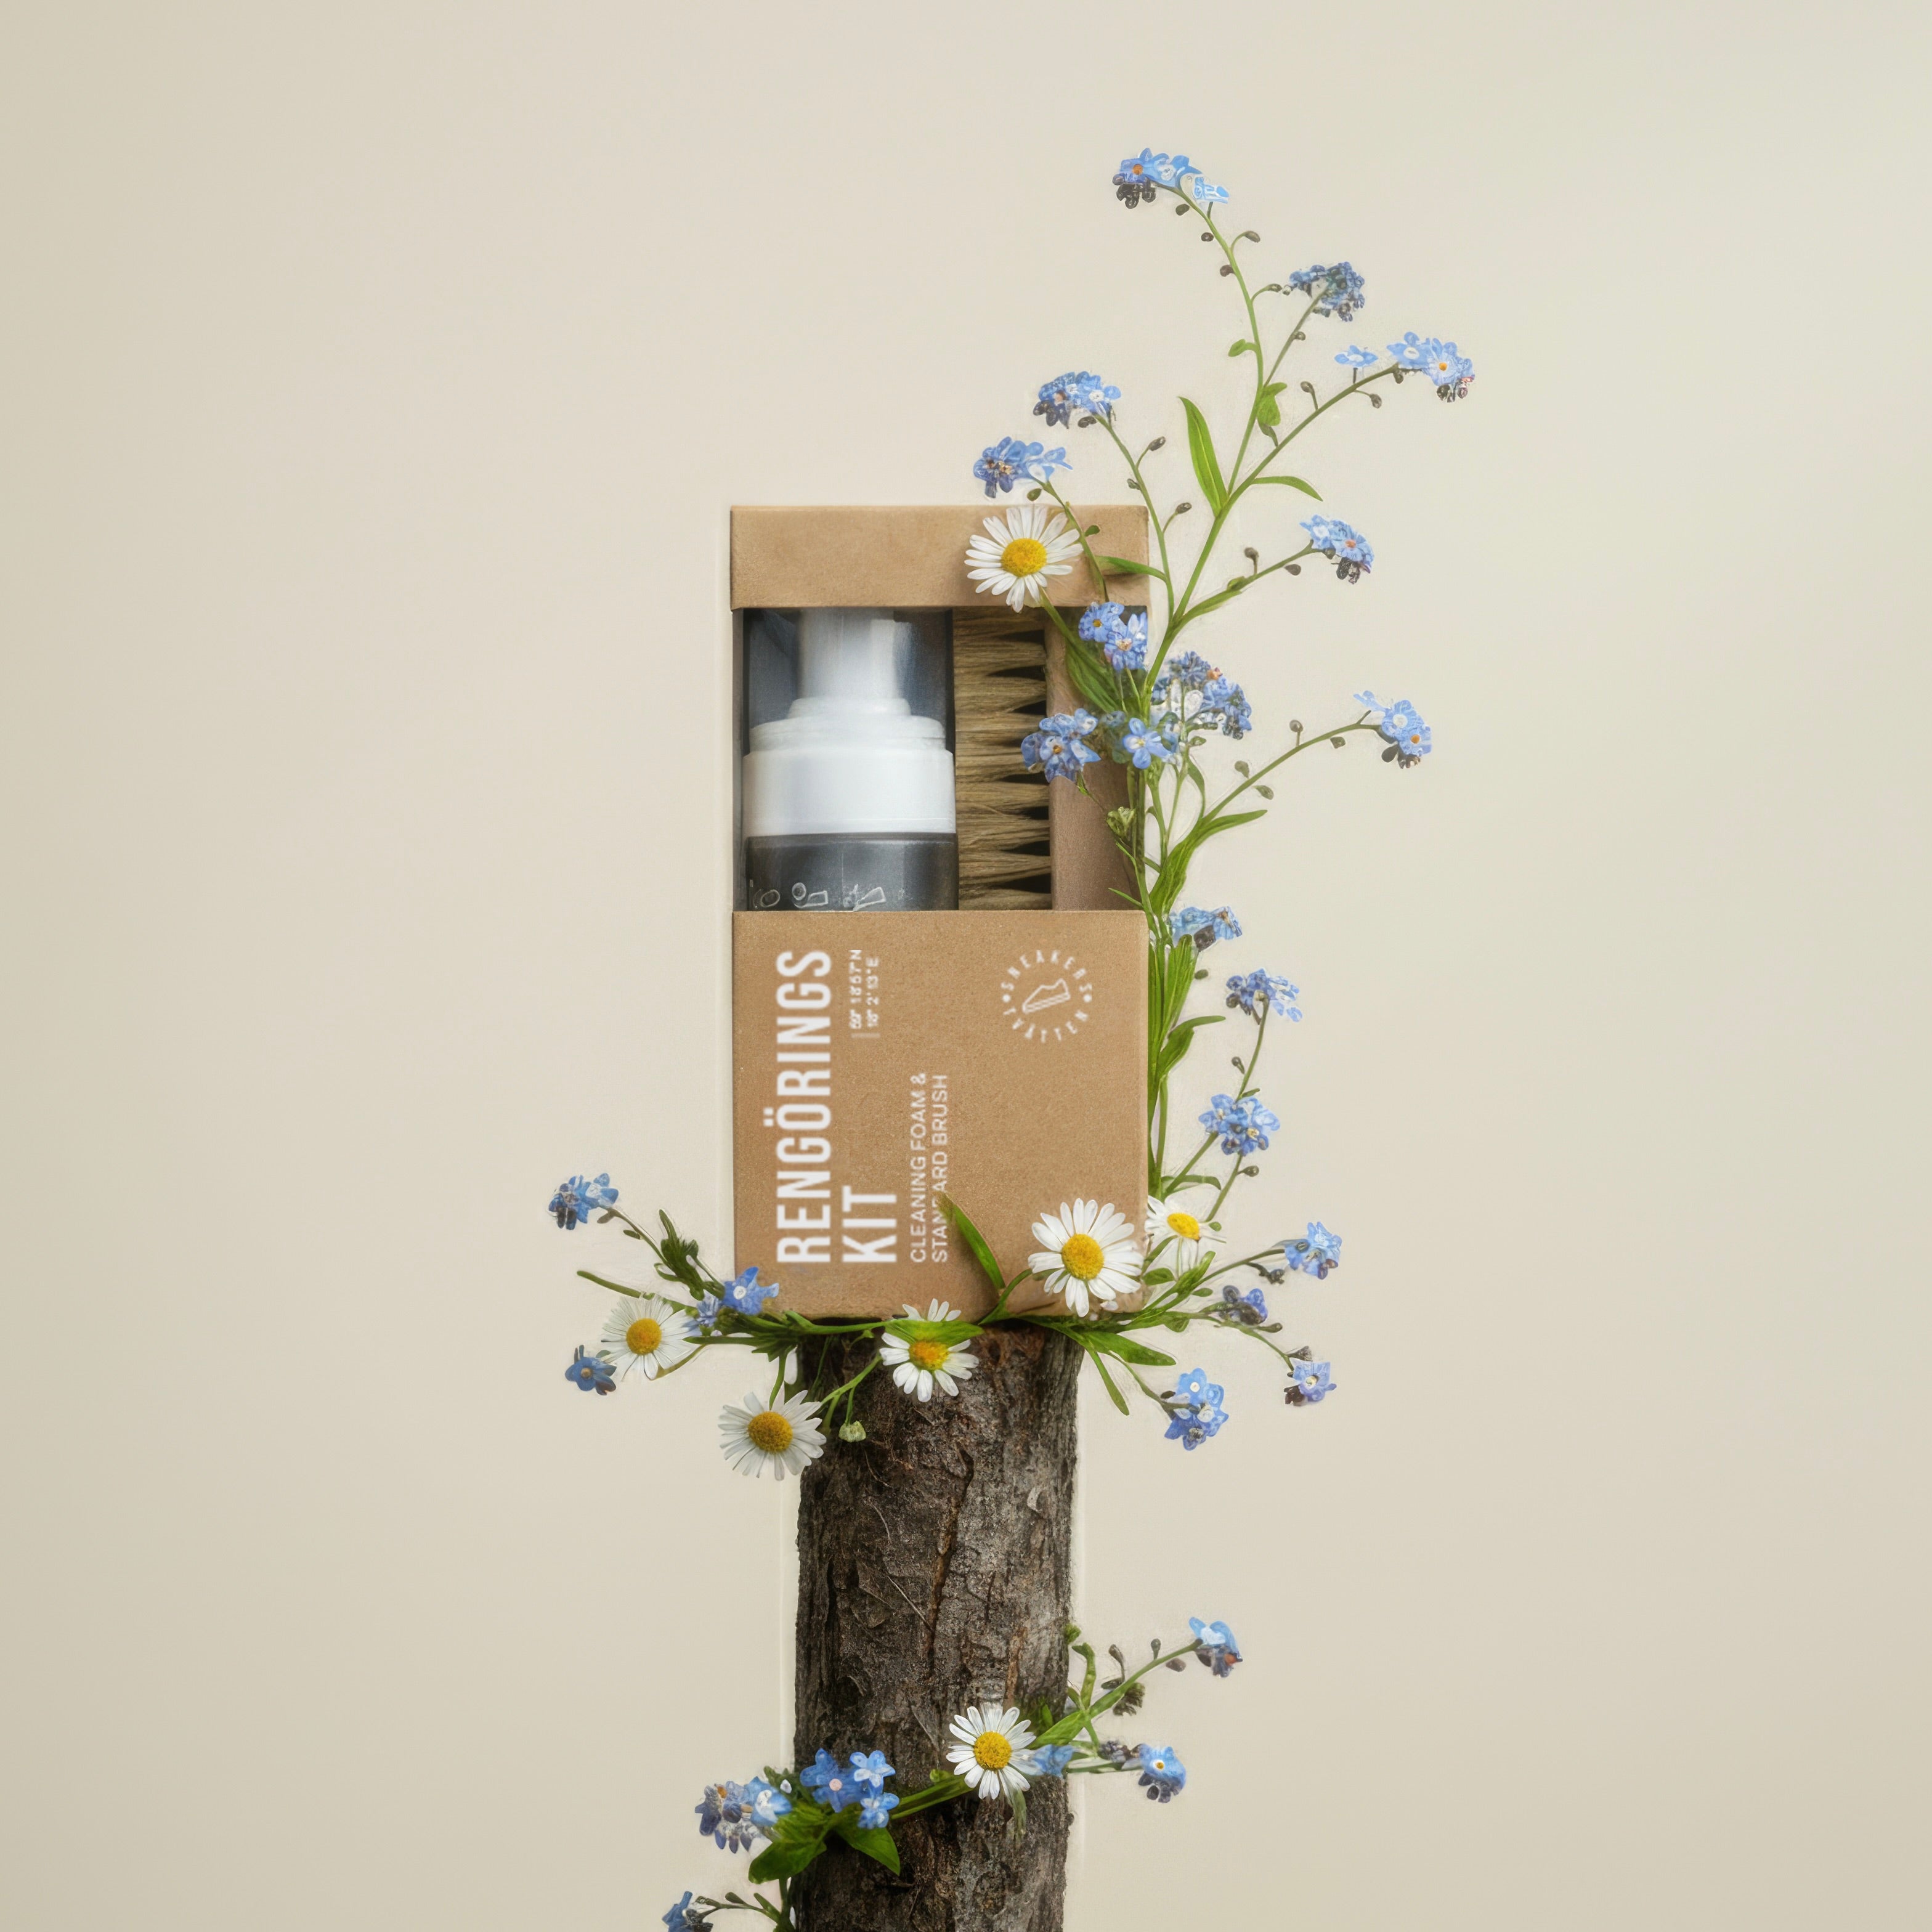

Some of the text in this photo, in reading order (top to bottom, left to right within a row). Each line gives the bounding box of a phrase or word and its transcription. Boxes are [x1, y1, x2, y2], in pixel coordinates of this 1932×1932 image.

[1000, 949, 1092, 992] SNEAKERS
[763, 949, 832, 1263] RENGÖRINGS
[932, 1074, 948, 1145] BRUSH
[909, 1072, 927, 1262] CLEANING FOAM &
[842, 1184, 897, 1263] KIT
